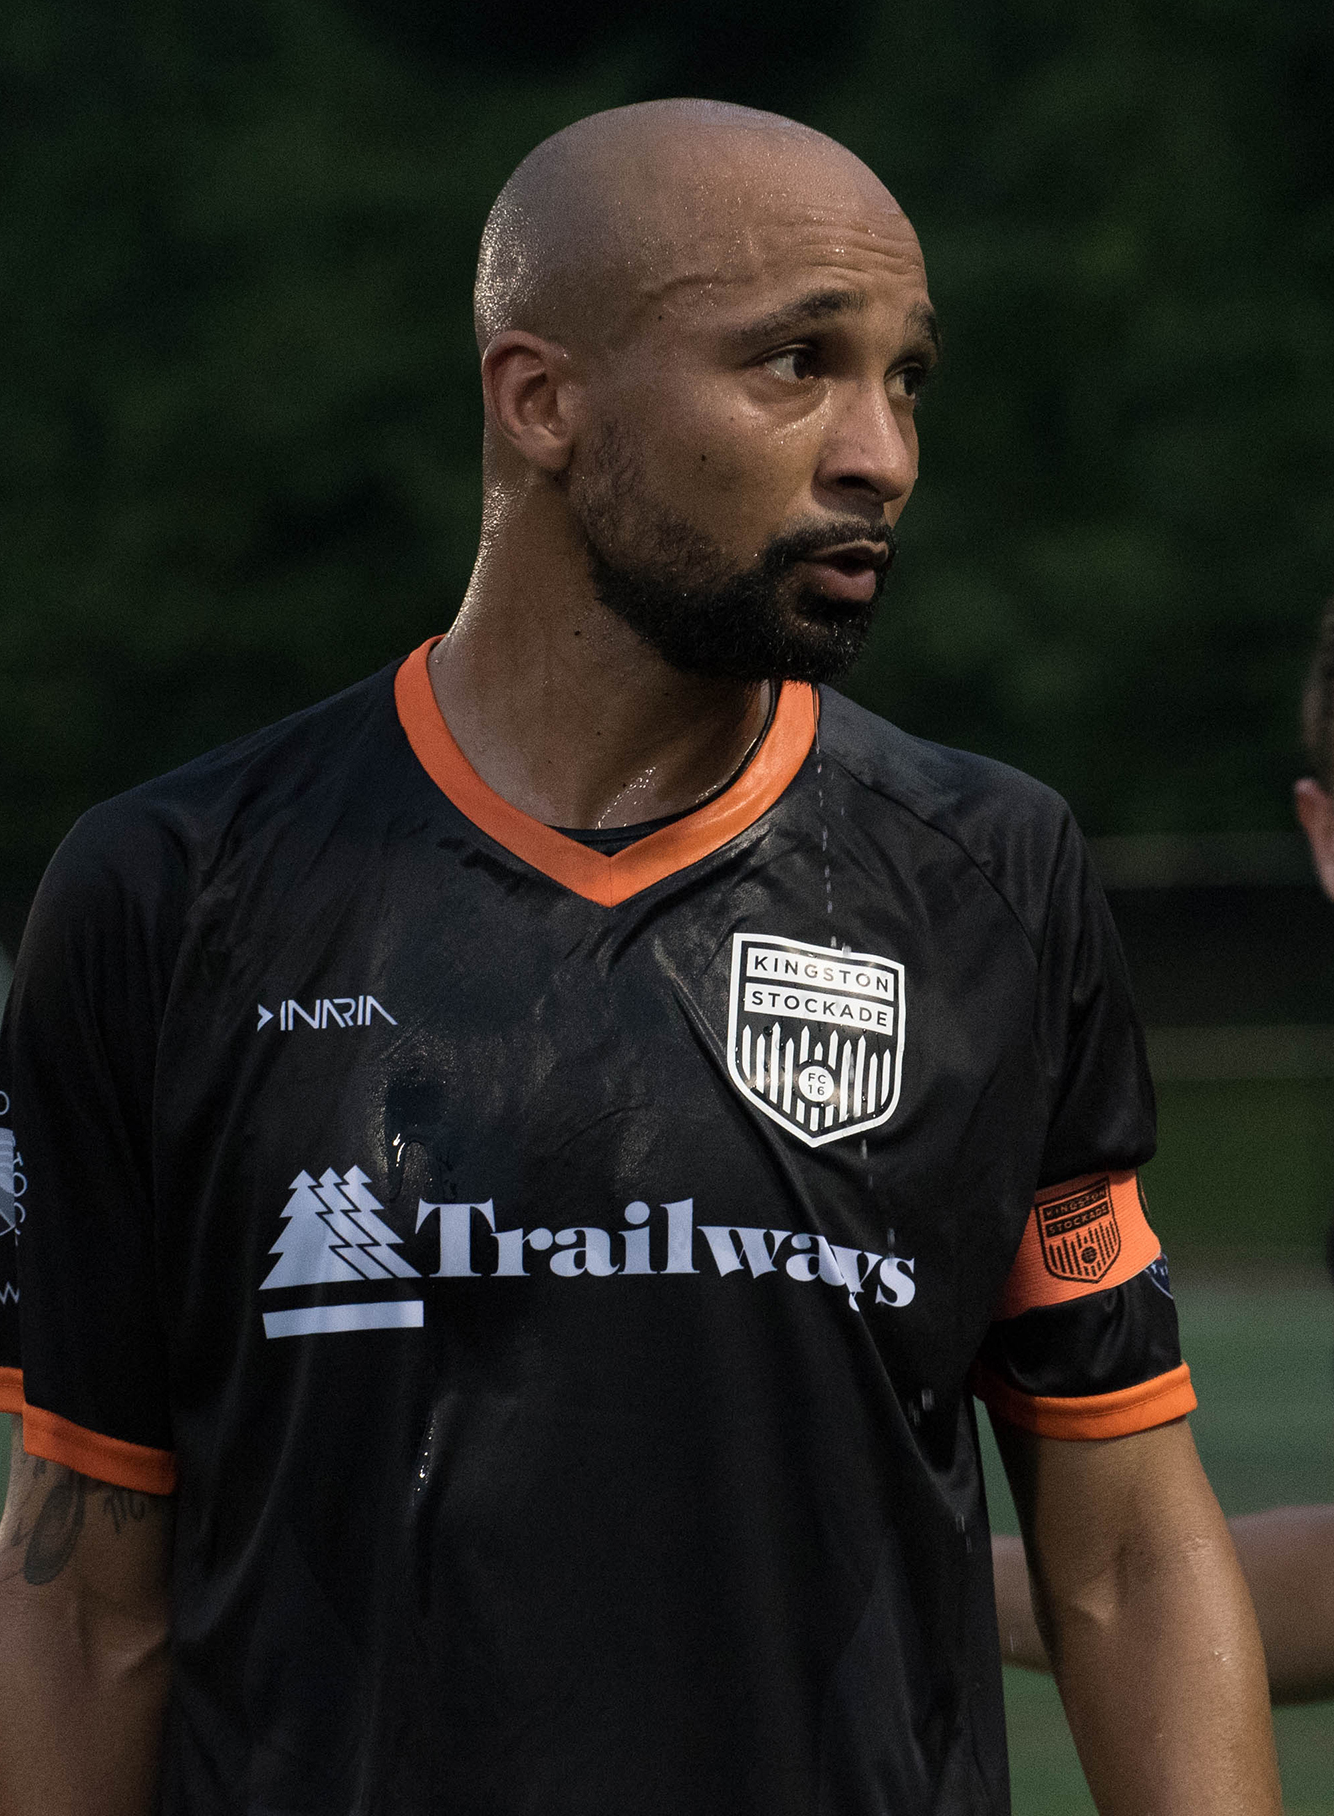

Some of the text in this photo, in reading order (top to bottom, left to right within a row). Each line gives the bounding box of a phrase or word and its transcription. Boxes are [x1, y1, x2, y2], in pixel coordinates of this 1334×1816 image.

[753, 955, 889, 993] KINGSTON
[280, 995, 399, 1031] INARIA
[751, 990, 888, 1027] STOCKADE
[807, 1072, 827, 1084] FC
[807, 1084, 825, 1096] 16
[1048, 1203, 1109, 1236] STOCKADE
[415, 1197, 916, 1312] Trailways
